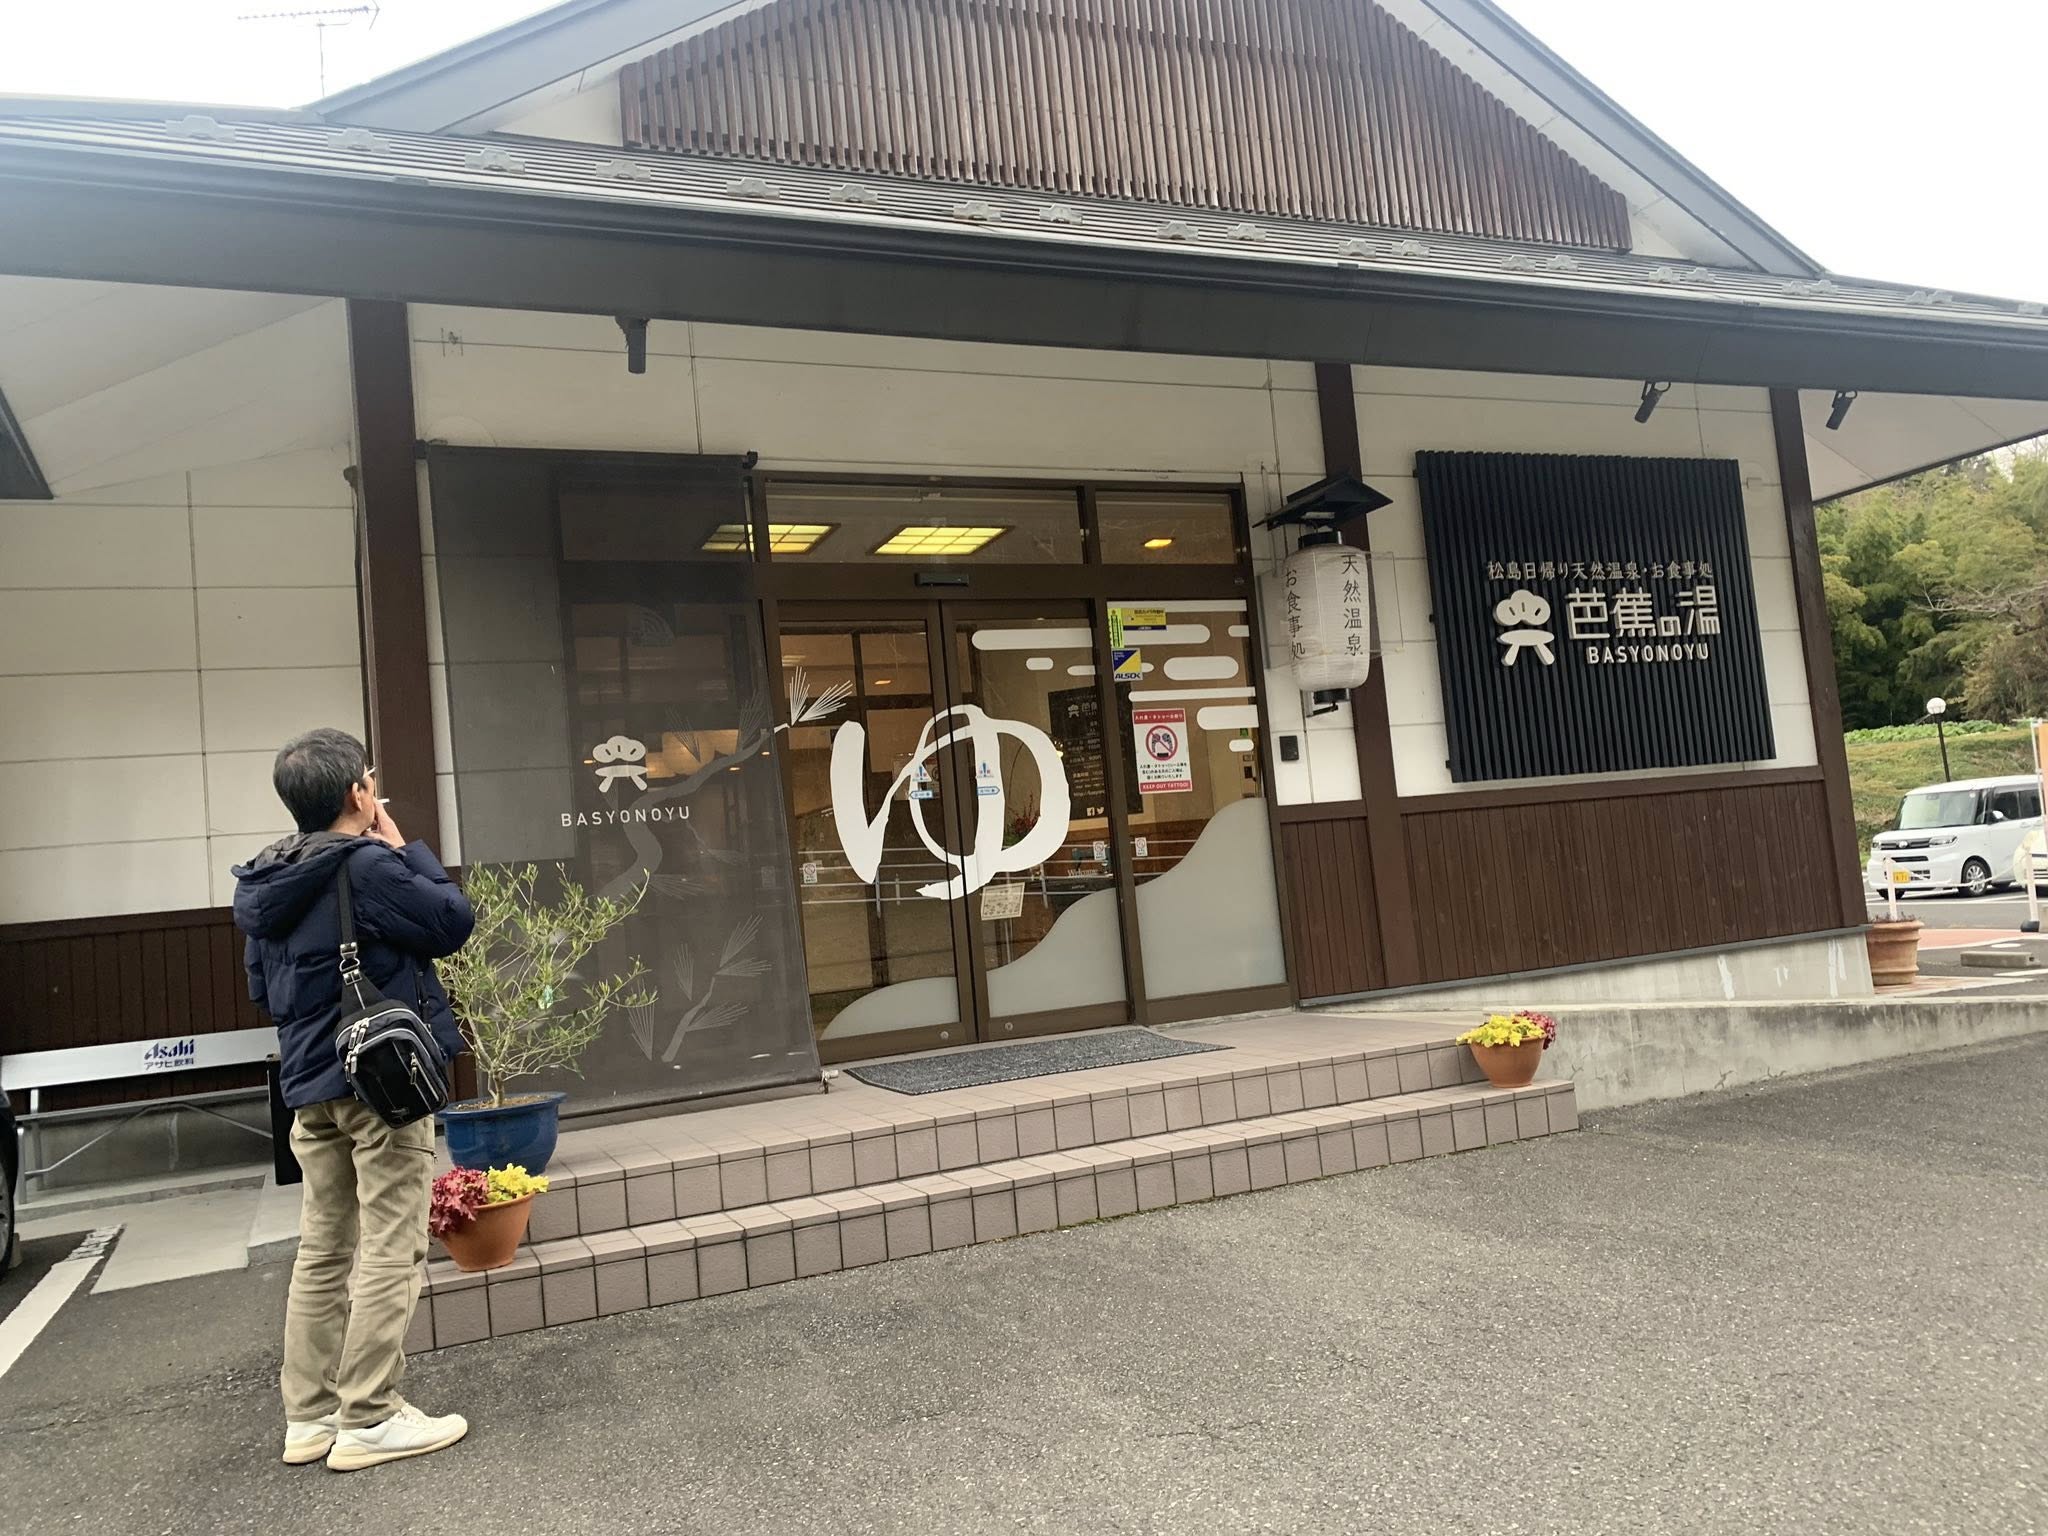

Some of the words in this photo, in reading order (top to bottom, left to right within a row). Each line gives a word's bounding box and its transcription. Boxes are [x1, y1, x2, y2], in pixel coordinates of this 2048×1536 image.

[1487, 560, 1714, 581] 松島日帰り天然温泉・お食事処
[1284, 568, 1306, 660] お食事処
[1341, 554, 1364, 657] 天然温泉
[1565, 585, 1721, 640] 芭蕉の湯
[1587, 643, 1709, 665] BASYONOYU
[1115, 672, 1141, 680] ALSOK
[830, 703, 1071, 900] ゆ
[561, 806, 690, 827] BASYONOYU
[144, 1039, 194, 1060] Asahi
[144, 1058, 194, 1070] アサヒ飲料
